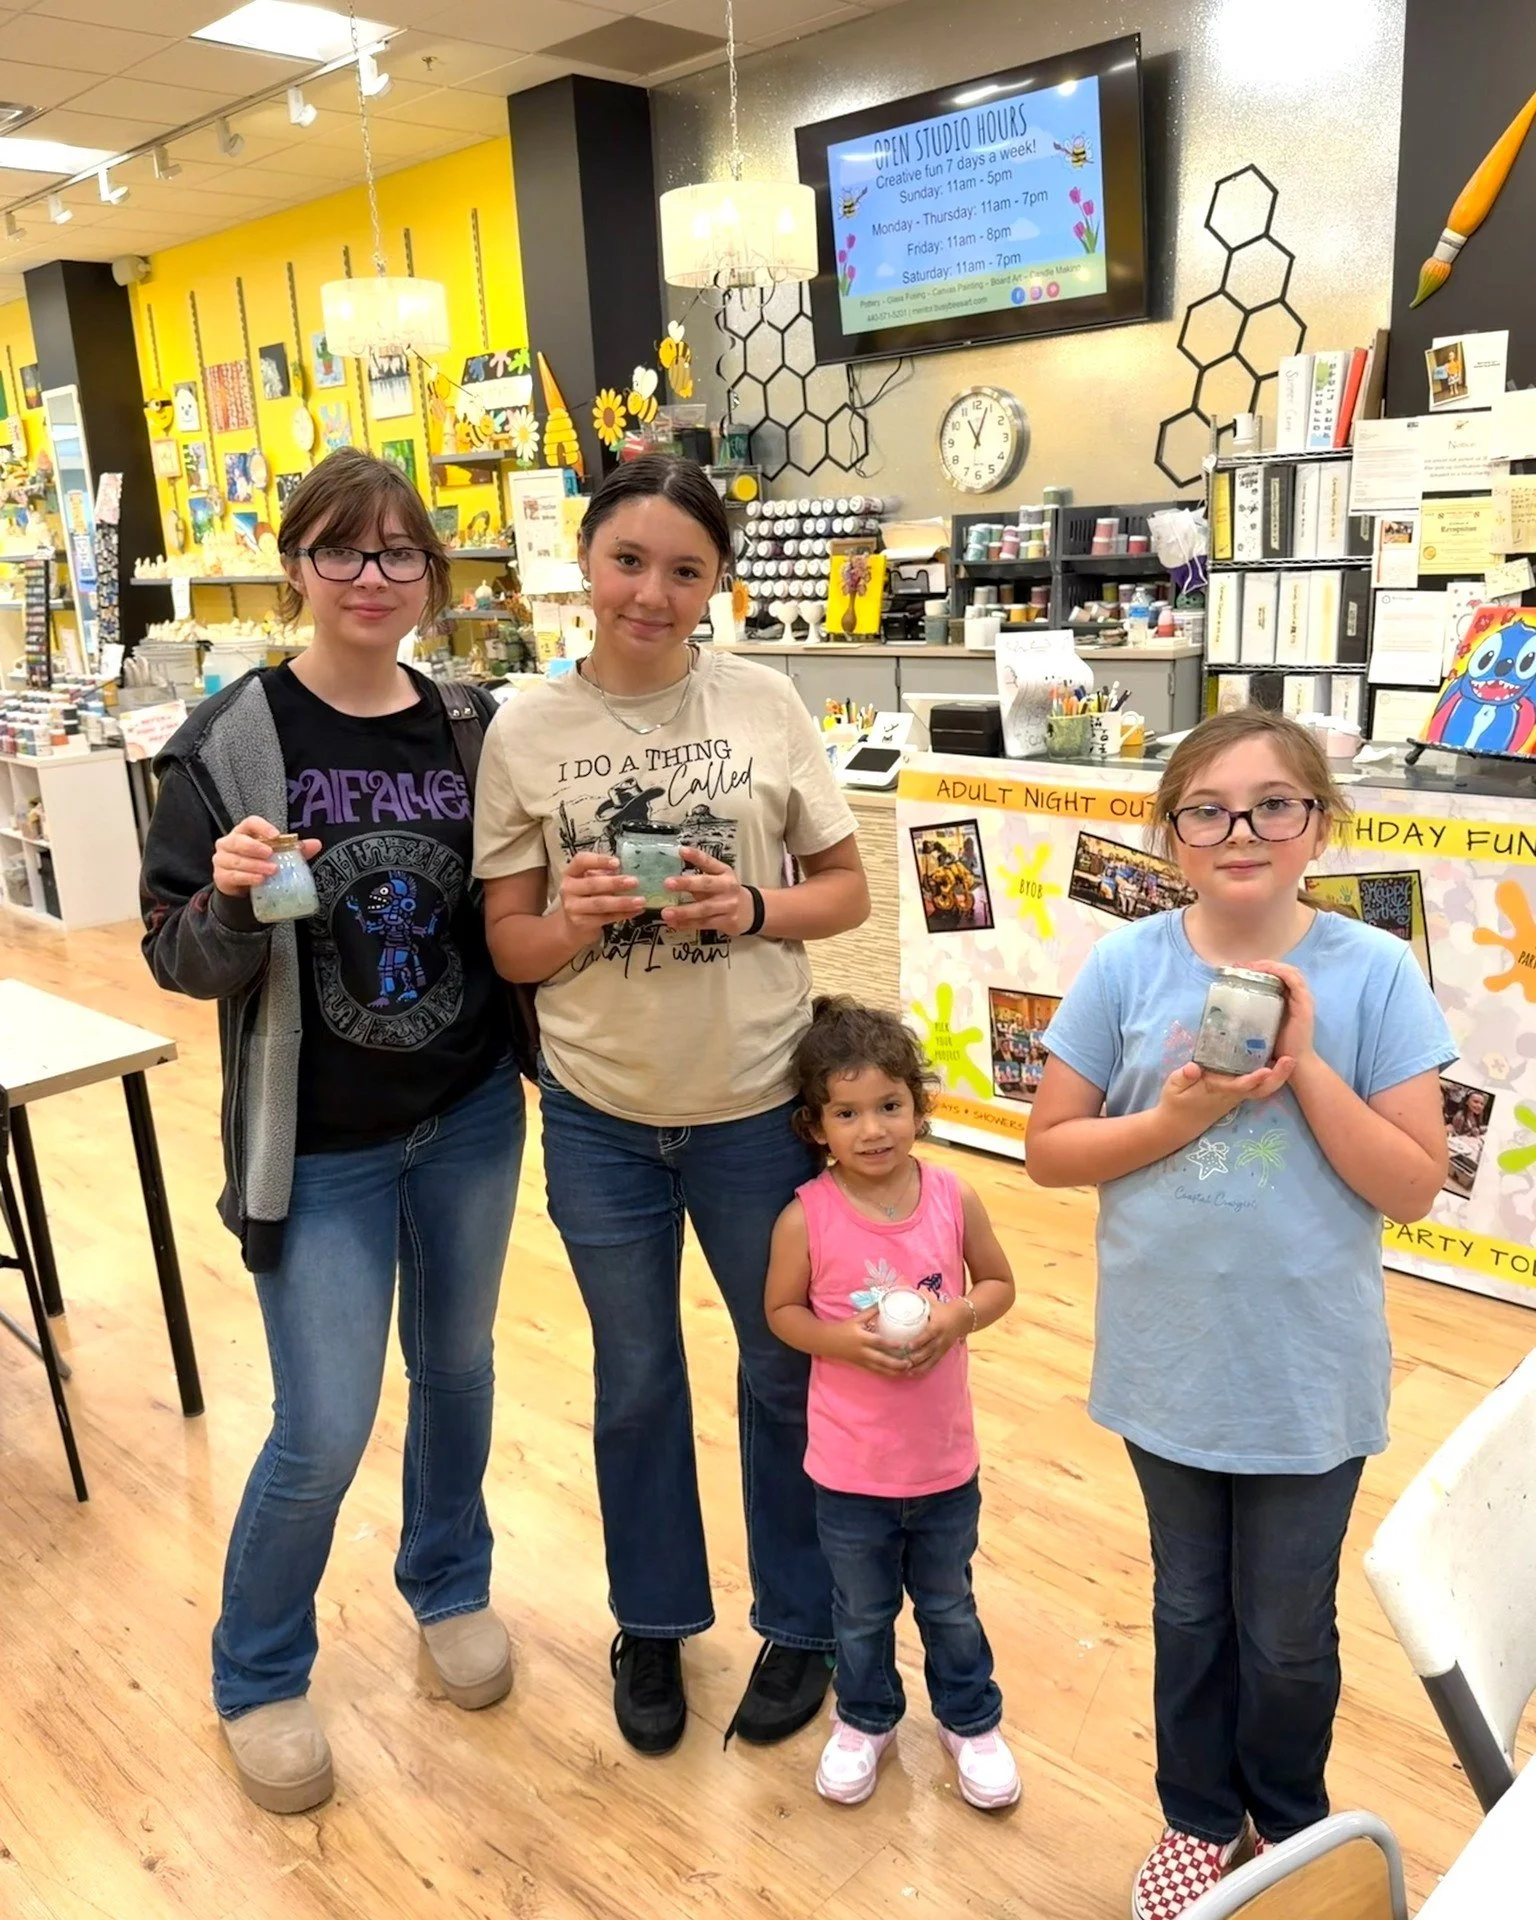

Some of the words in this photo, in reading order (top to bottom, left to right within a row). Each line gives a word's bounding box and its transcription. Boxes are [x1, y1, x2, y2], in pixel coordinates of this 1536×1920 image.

[874, 132, 909, 170] OPEN
[915, 117, 971, 162] STUDIO
[977, 103, 1027, 145] HOURS
[876, 167, 922, 190] Creative
[925, 163, 943, 178] fun
[946, 159, 953, 173] 7
[957, 153, 985, 171] days
[989, 151, 996, 162] a
[999, 140, 1036, 161] week!
[900, 186, 944, 204] Sunday:
[947, 177, 977, 193] 11am
[987, 169, 1012, 186] 5pm
[872, 217, 913, 237] Monday
[923, 206, 977, 226] Thursday:
[981, 198, 1011, 214] 11am
[1022, 190, 1048, 207] 7pm
[907, 240, 944, 256] Friday:
[947, 232, 976, 248] 11am
[987, 225, 1012, 242] 8pm
[902, 266, 952, 285] Saturday:
[956, 258, 985, 275] 11am
[996, 252, 1021, 269] 7pm
[957, 281, 984, 292] Painting
[991, 275, 1011, 285] Board
[961, 407, 968, 417] 11
[972, 400, 982, 410] 12
[951, 421, 961, 431] 10
[997, 416, 1005, 426] 2
[947, 439, 955, 448] 9
[1002, 433, 1009, 443] 3
[952, 455, 959, 465] 8
[988, 464, 995, 474] 5
[997, 451, 1005, 460] 4
[963, 467, 970, 476] 7
[975, 470, 982, 480] 6
[557, 762, 568, 783] I
[574, 754, 611, 780] DO
[618, 755, 640, 774] A
[645, 739, 732, 772] THING
[668, 757, 753, 807] Called
[286, 767, 473, 829] AIFANE
[936, 779, 1013, 804] ADULT
[1024, 787, 1096, 813] NIGHT
[1333, 817, 1446, 848] THDAY
[1019, 878, 1043, 899] BYOB
[1361, 880, 1411, 907] Happy
[672, 937, 732, 969] want
[941, 1102, 960, 1114] AYS
[973, 1109, 1025, 1131] SHOWERS
